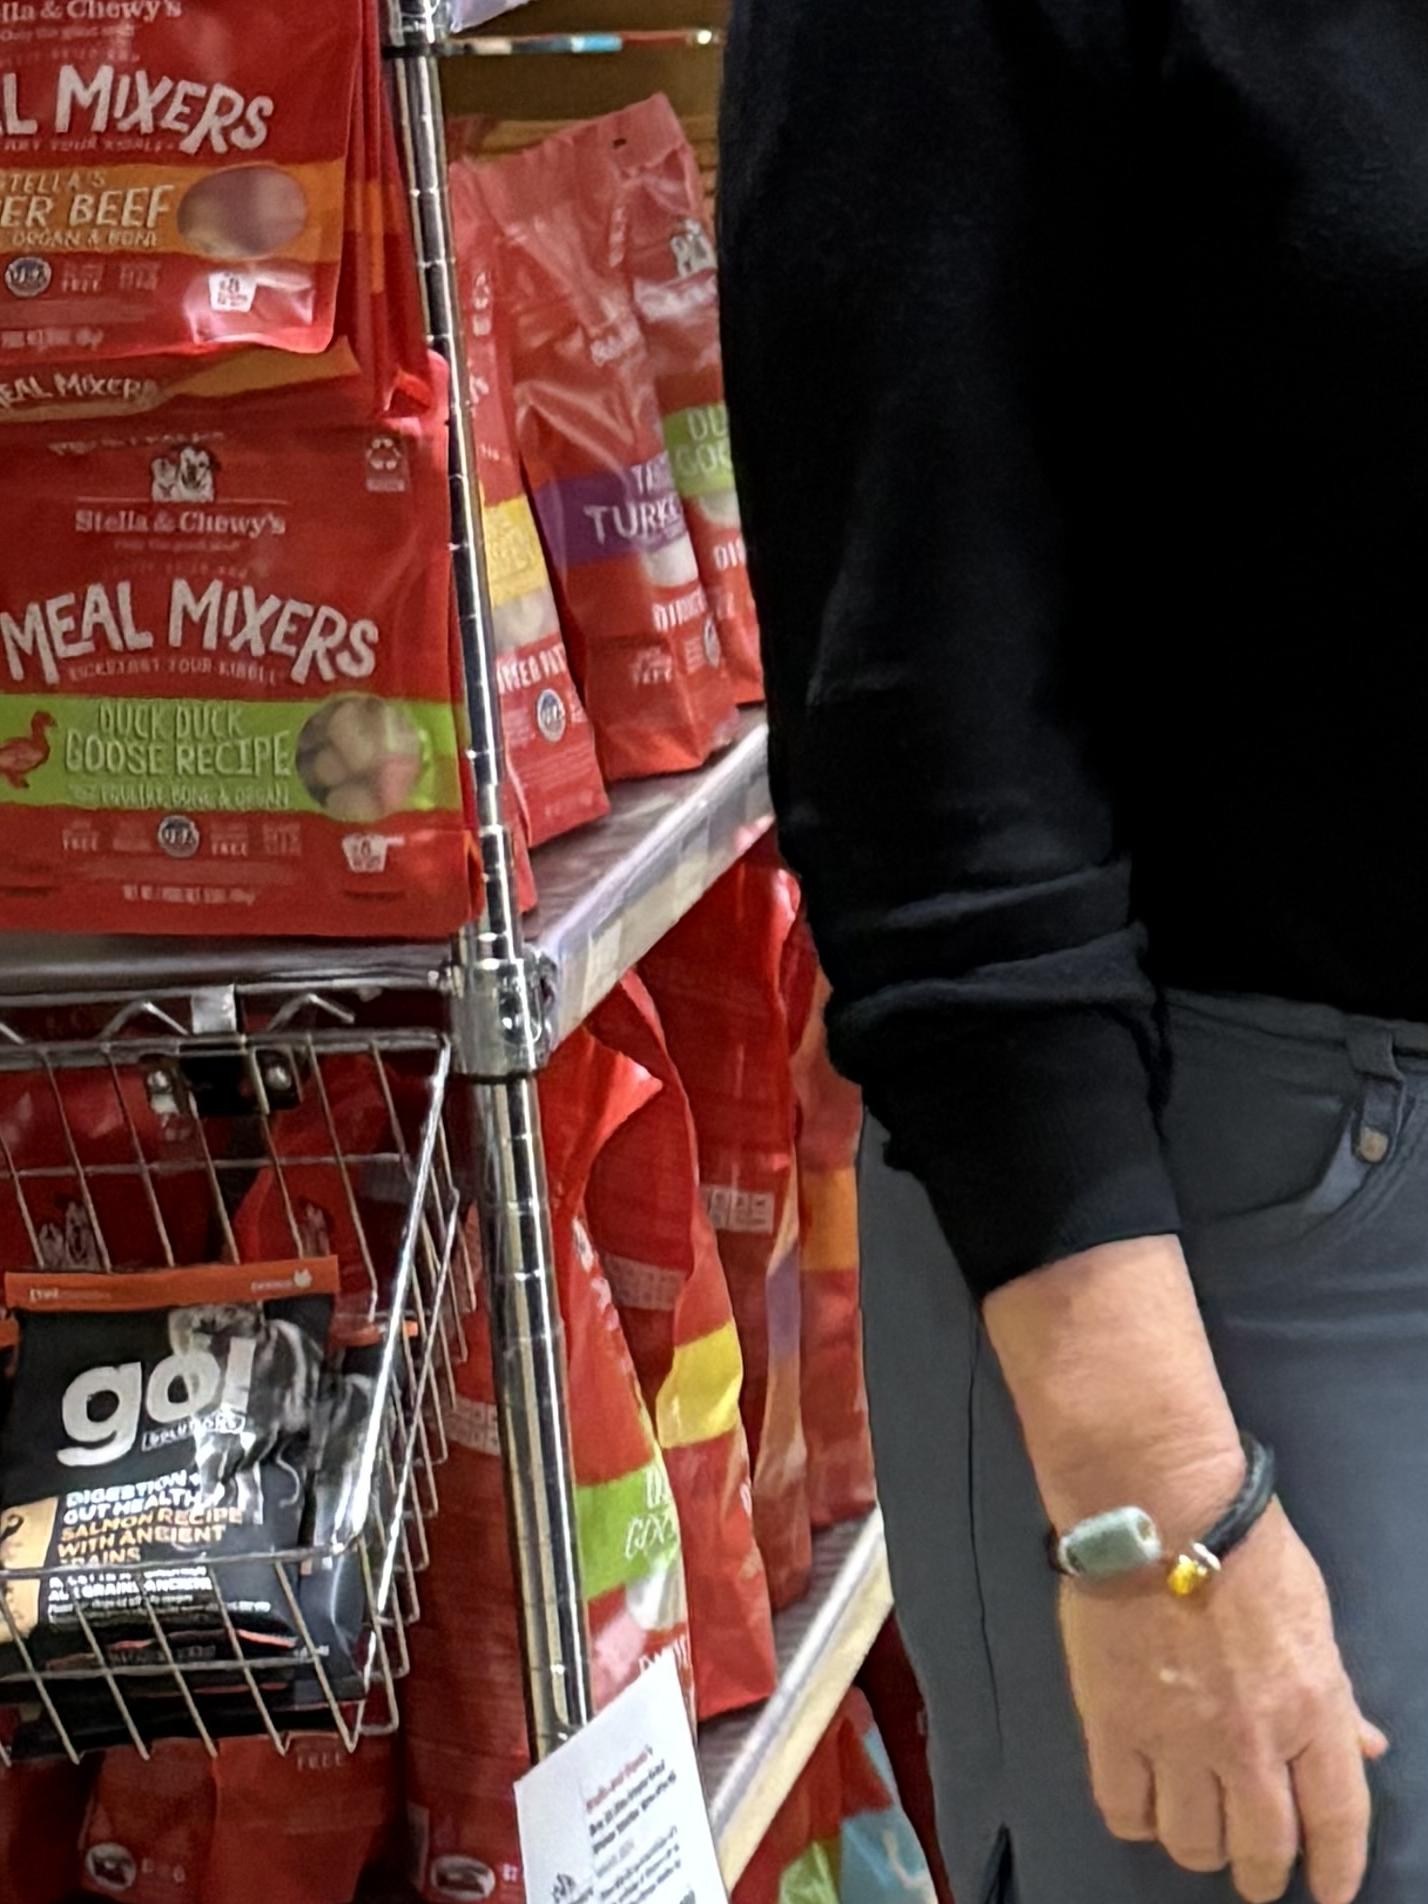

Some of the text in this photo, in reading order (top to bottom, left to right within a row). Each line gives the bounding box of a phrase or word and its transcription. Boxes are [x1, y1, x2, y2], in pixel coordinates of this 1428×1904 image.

[54, 63, 275, 156] MIXERS
[68, 185, 175, 229] BEEF
[75, 509, 148, 533] Stella
[179, 510, 286, 539] Chewy's
[1, 580, 153, 685] MEAL
[168, 577, 380, 685] MIXERS
[100, 704, 243, 741] DUCK DUCK
[65, 728, 291, 777] GOOSE RECIPE
[56, 1337, 257, 1467] go!
[66, 1469, 188, 1509] DIGESTION
[60, 1506, 243, 1542] SALMON RECIPE
[62, 1501, 110, 1525] GUT
[57, 1525, 226, 1558] WITH ANCIENT
